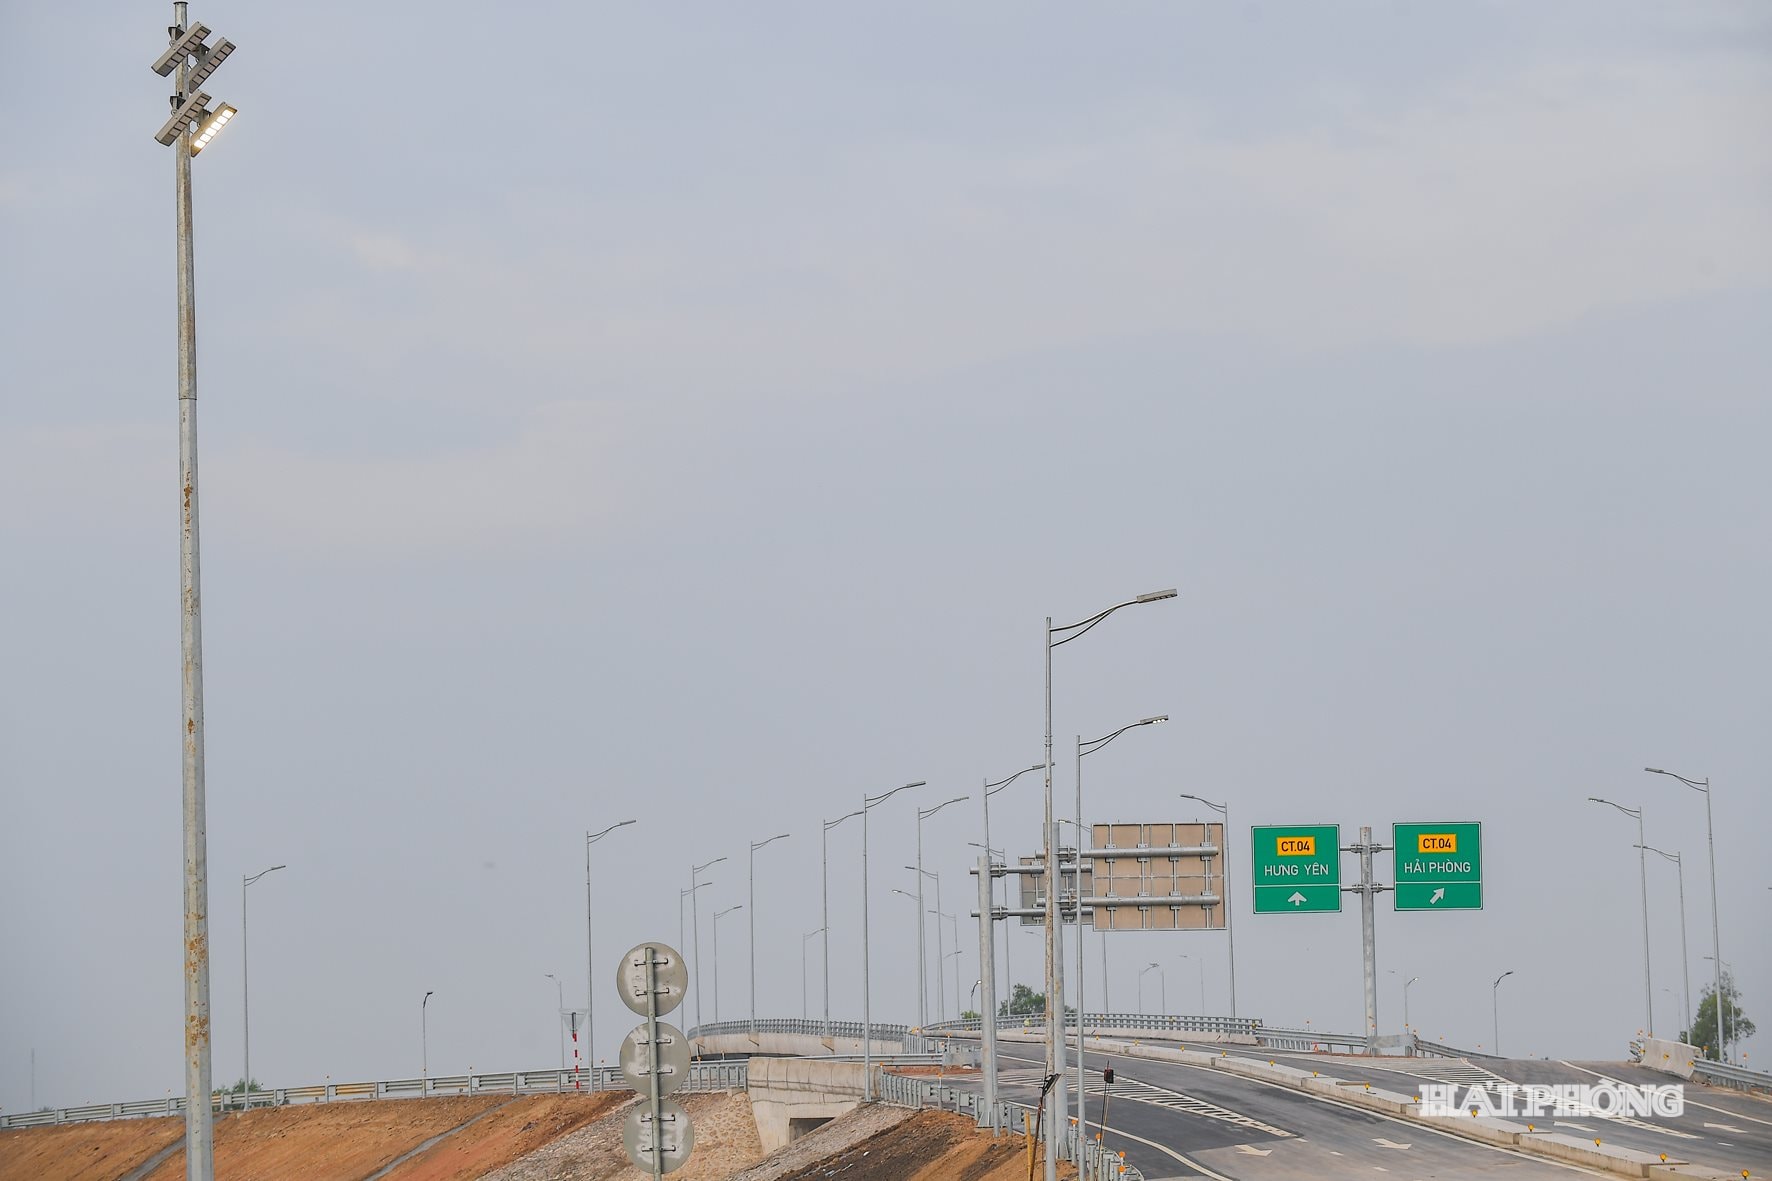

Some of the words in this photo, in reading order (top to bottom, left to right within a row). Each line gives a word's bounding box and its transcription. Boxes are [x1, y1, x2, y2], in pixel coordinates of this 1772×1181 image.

[1281, 841, 1310, 852] CT.04
[1422, 838, 1452, 849] CT.04
[1264, 864, 1299, 877] HƯNG
[1304, 862, 1329, 876] YÊN
[1404, 859, 1426, 874] HẢI
[1429, 859, 1471, 873] PHÒNG
